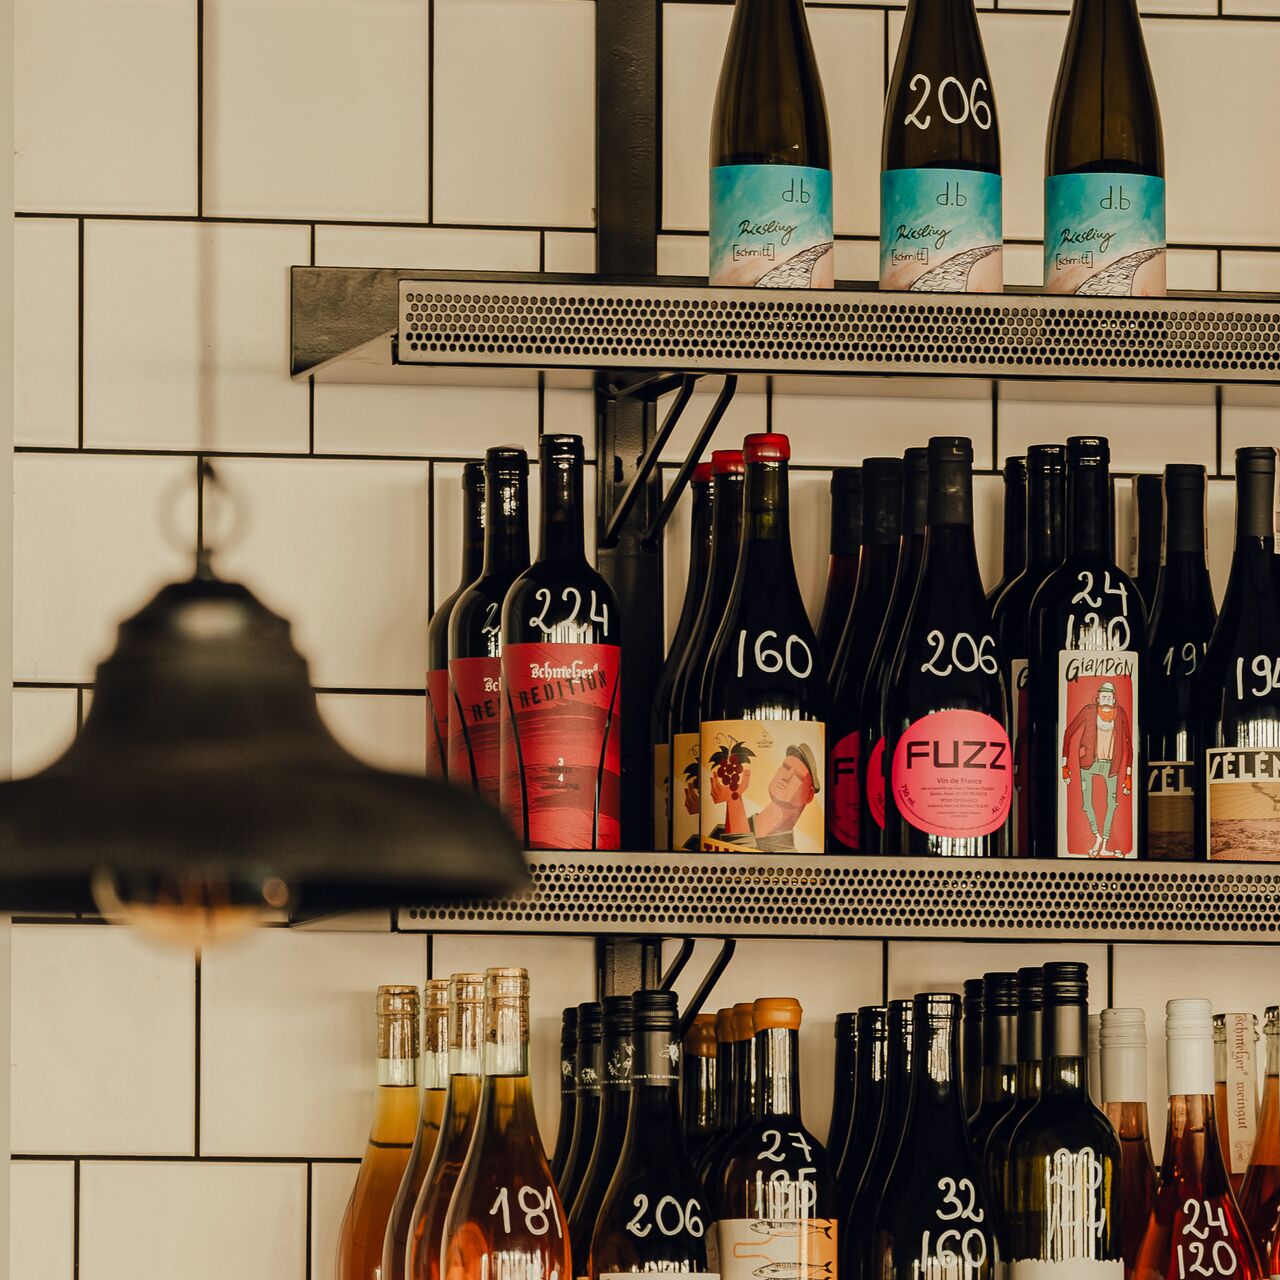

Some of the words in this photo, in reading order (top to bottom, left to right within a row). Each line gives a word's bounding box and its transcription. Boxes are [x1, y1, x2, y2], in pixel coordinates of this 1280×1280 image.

[904, 73, 992, 130] 206
[738, 219, 799, 245] Riesling
[896, 223, 952, 249] Riesling
[1060, 227, 1117, 253] Riesling
[529, 587, 609, 636] 224
[1071, 571, 1128, 616] 24
[737, 630, 813, 678] 160
[920, 629, 998, 677] 206
[906, 740, 1006, 770] FUZZ
[757, 1129, 812, 1162] 27
[489, 1185, 564, 1239] 181
[626, 1193, 705, 1239] 206
[936, 1177, 984, 1223] 32
[1182, 1198, 1229, 1240] 24
[921, 1228, 986, 1273] 160
[1177, 1240, 1237, 1280] 120
